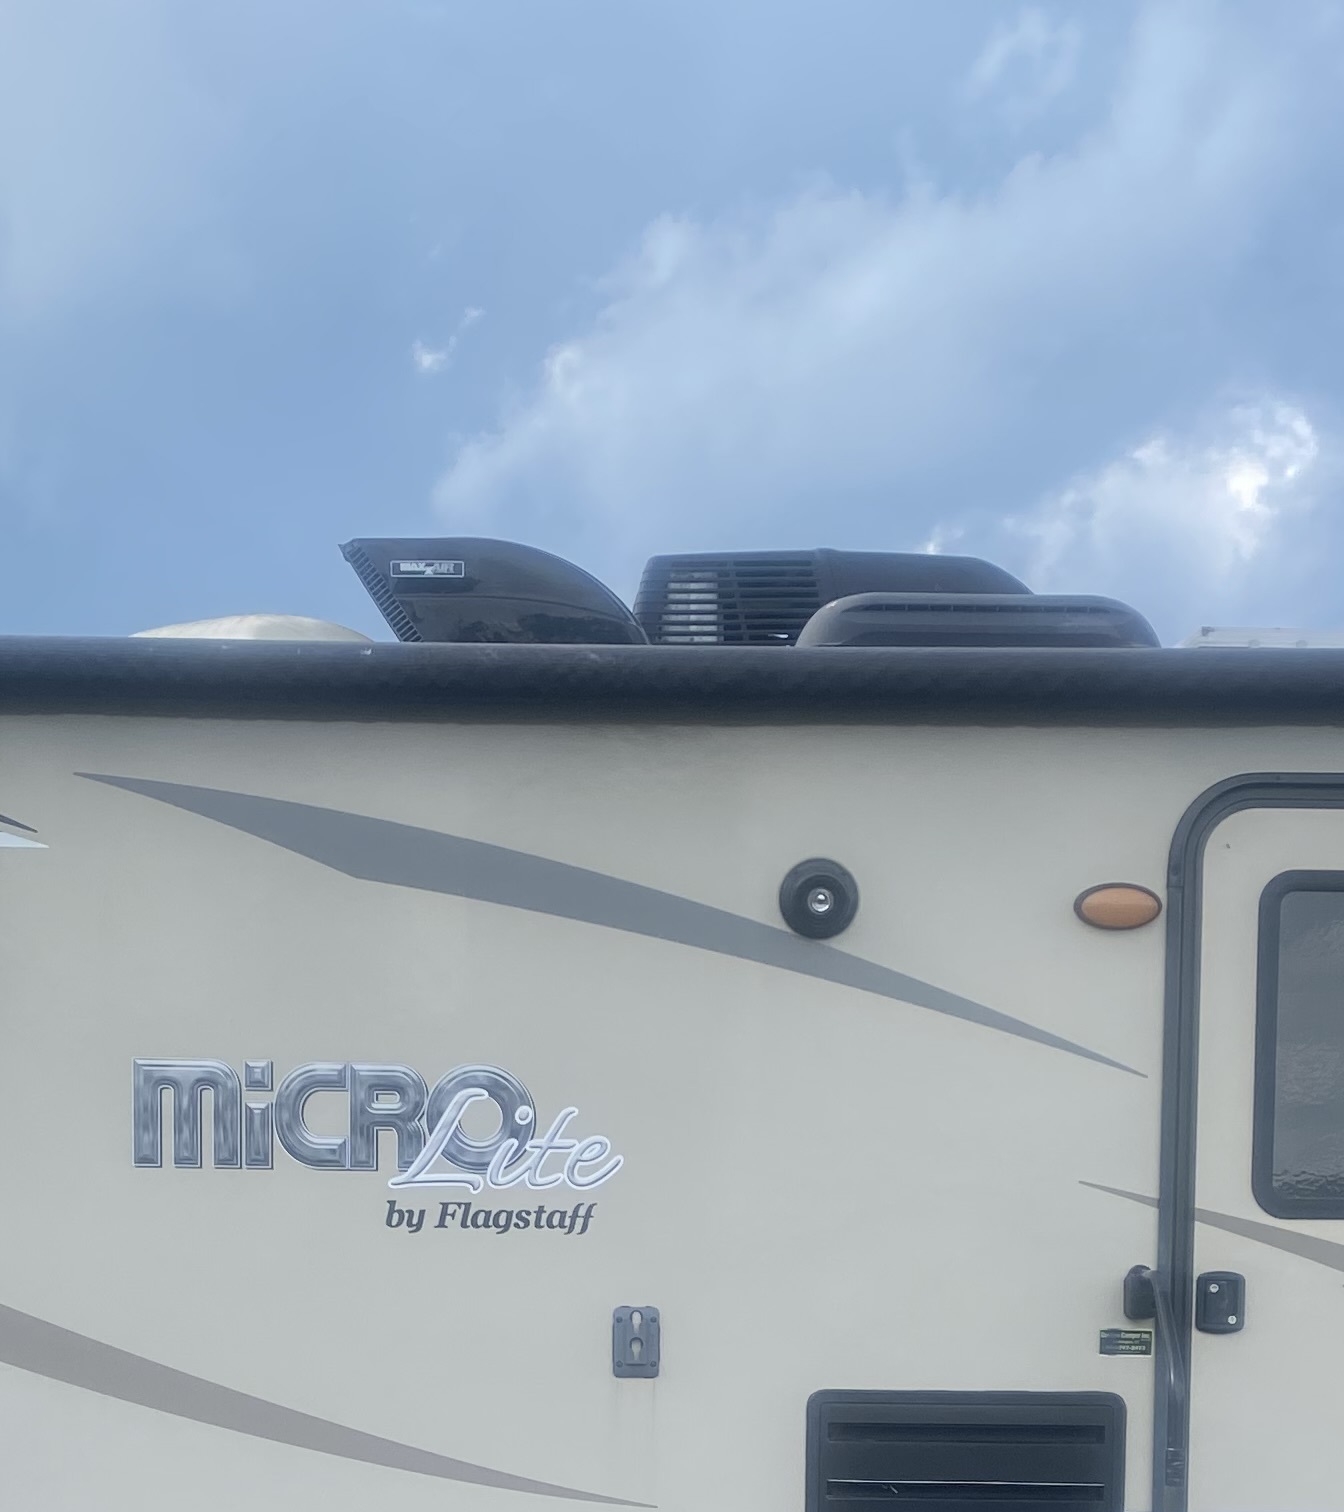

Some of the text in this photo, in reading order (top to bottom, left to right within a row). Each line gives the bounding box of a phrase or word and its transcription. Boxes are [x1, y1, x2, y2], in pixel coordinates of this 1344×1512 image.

[387, 1087, 625, 1193] Lite
[385, 1200, 598, 1235] by Flagstaff
